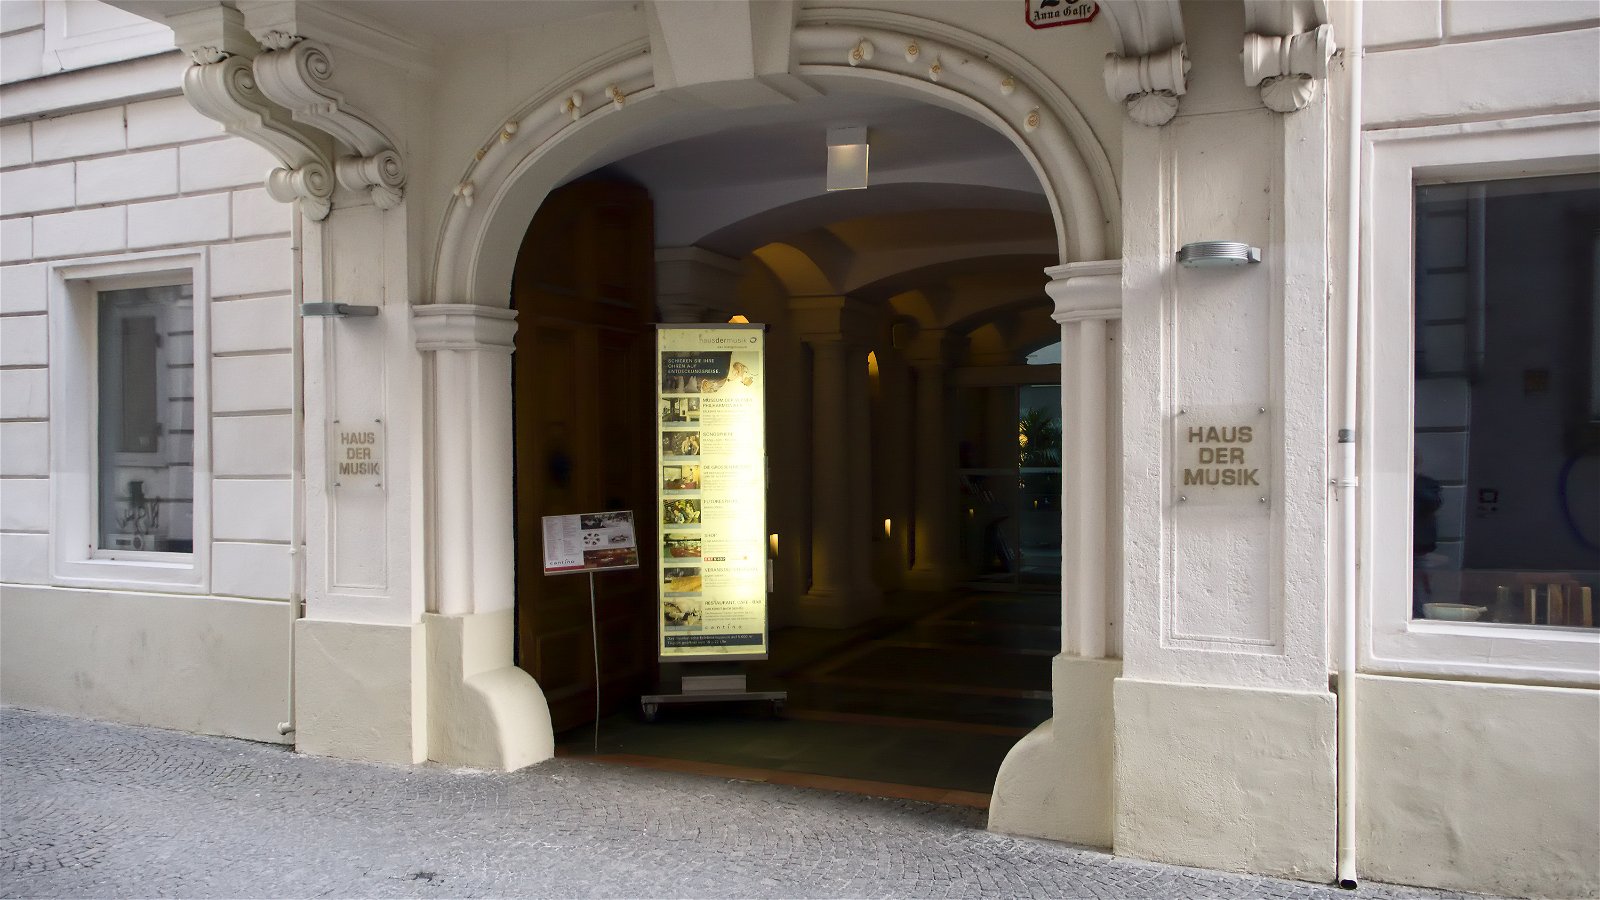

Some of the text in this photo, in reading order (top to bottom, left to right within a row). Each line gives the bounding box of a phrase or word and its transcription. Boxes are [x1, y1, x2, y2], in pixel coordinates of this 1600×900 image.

[1033, 10, 1060, 22] Anna
[341, 432, 375, 445] HAUS
[1188, 426, 1253, 443] HAUS
[347, 447, 371, 460] DER
[1199, 447, 1245, 465] DER
[339, 462, 380, 475] MUSIK
[1183, 468, 1260, 486] MUSIK
